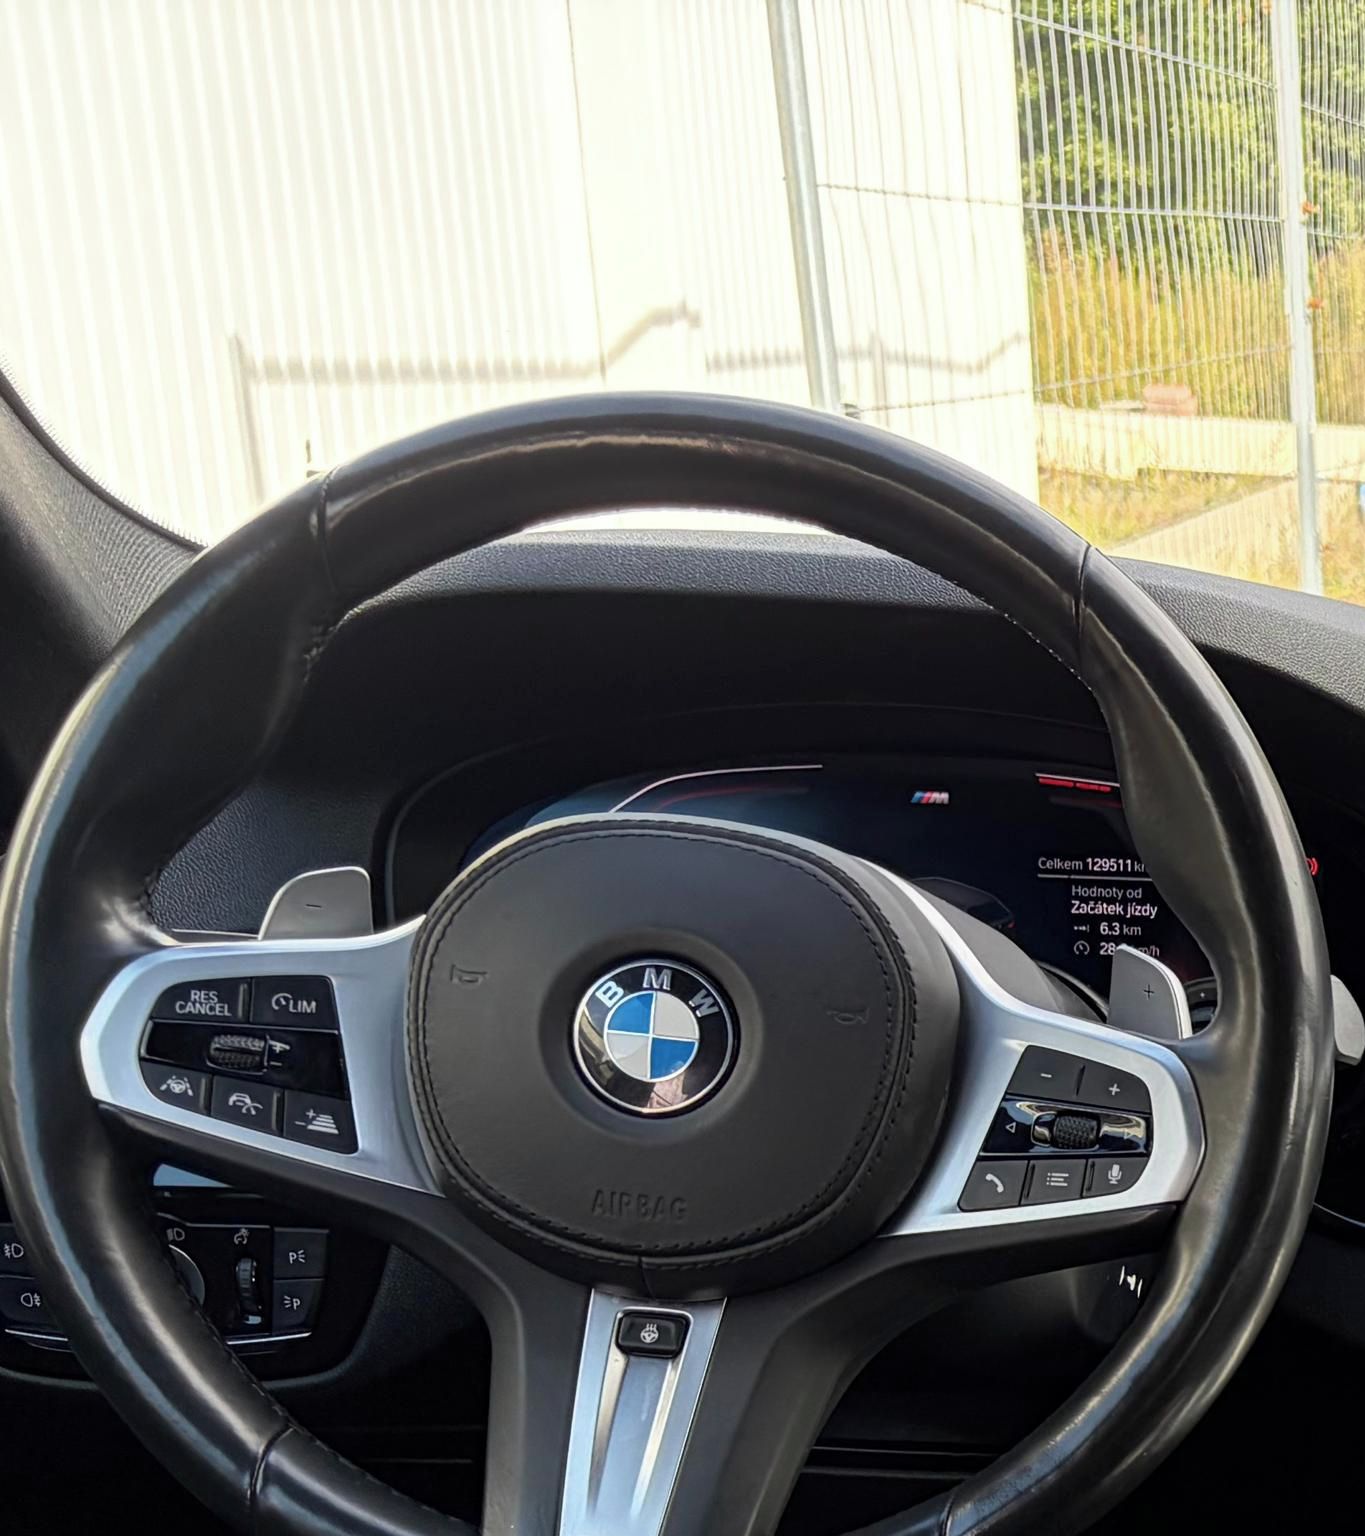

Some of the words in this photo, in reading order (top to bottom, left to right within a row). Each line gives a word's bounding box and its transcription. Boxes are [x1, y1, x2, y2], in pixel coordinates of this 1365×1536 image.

[1037, 856, 1083, 871] Celkem
[1085, 857, 1132, 873] 129511
[1071, 885, 1124, 900] Hodnoty
[1126, 886, 1142, 899] od
[1070, 900, 1124, 916] Začátek
[1126, 902, 1158, 919] jízdy
[1099, 921, 1121, 936] 6.3
[1123, 923, 1142, 936] km
[190, 989, 219, 1003] RES
[595, 966, 721, 1020] BMW
[175, 1001, 233, 1016] CANCEL
[288, 999, 317, 1014] LIM
[590, 1188, 688, 1222] AIRBAG
